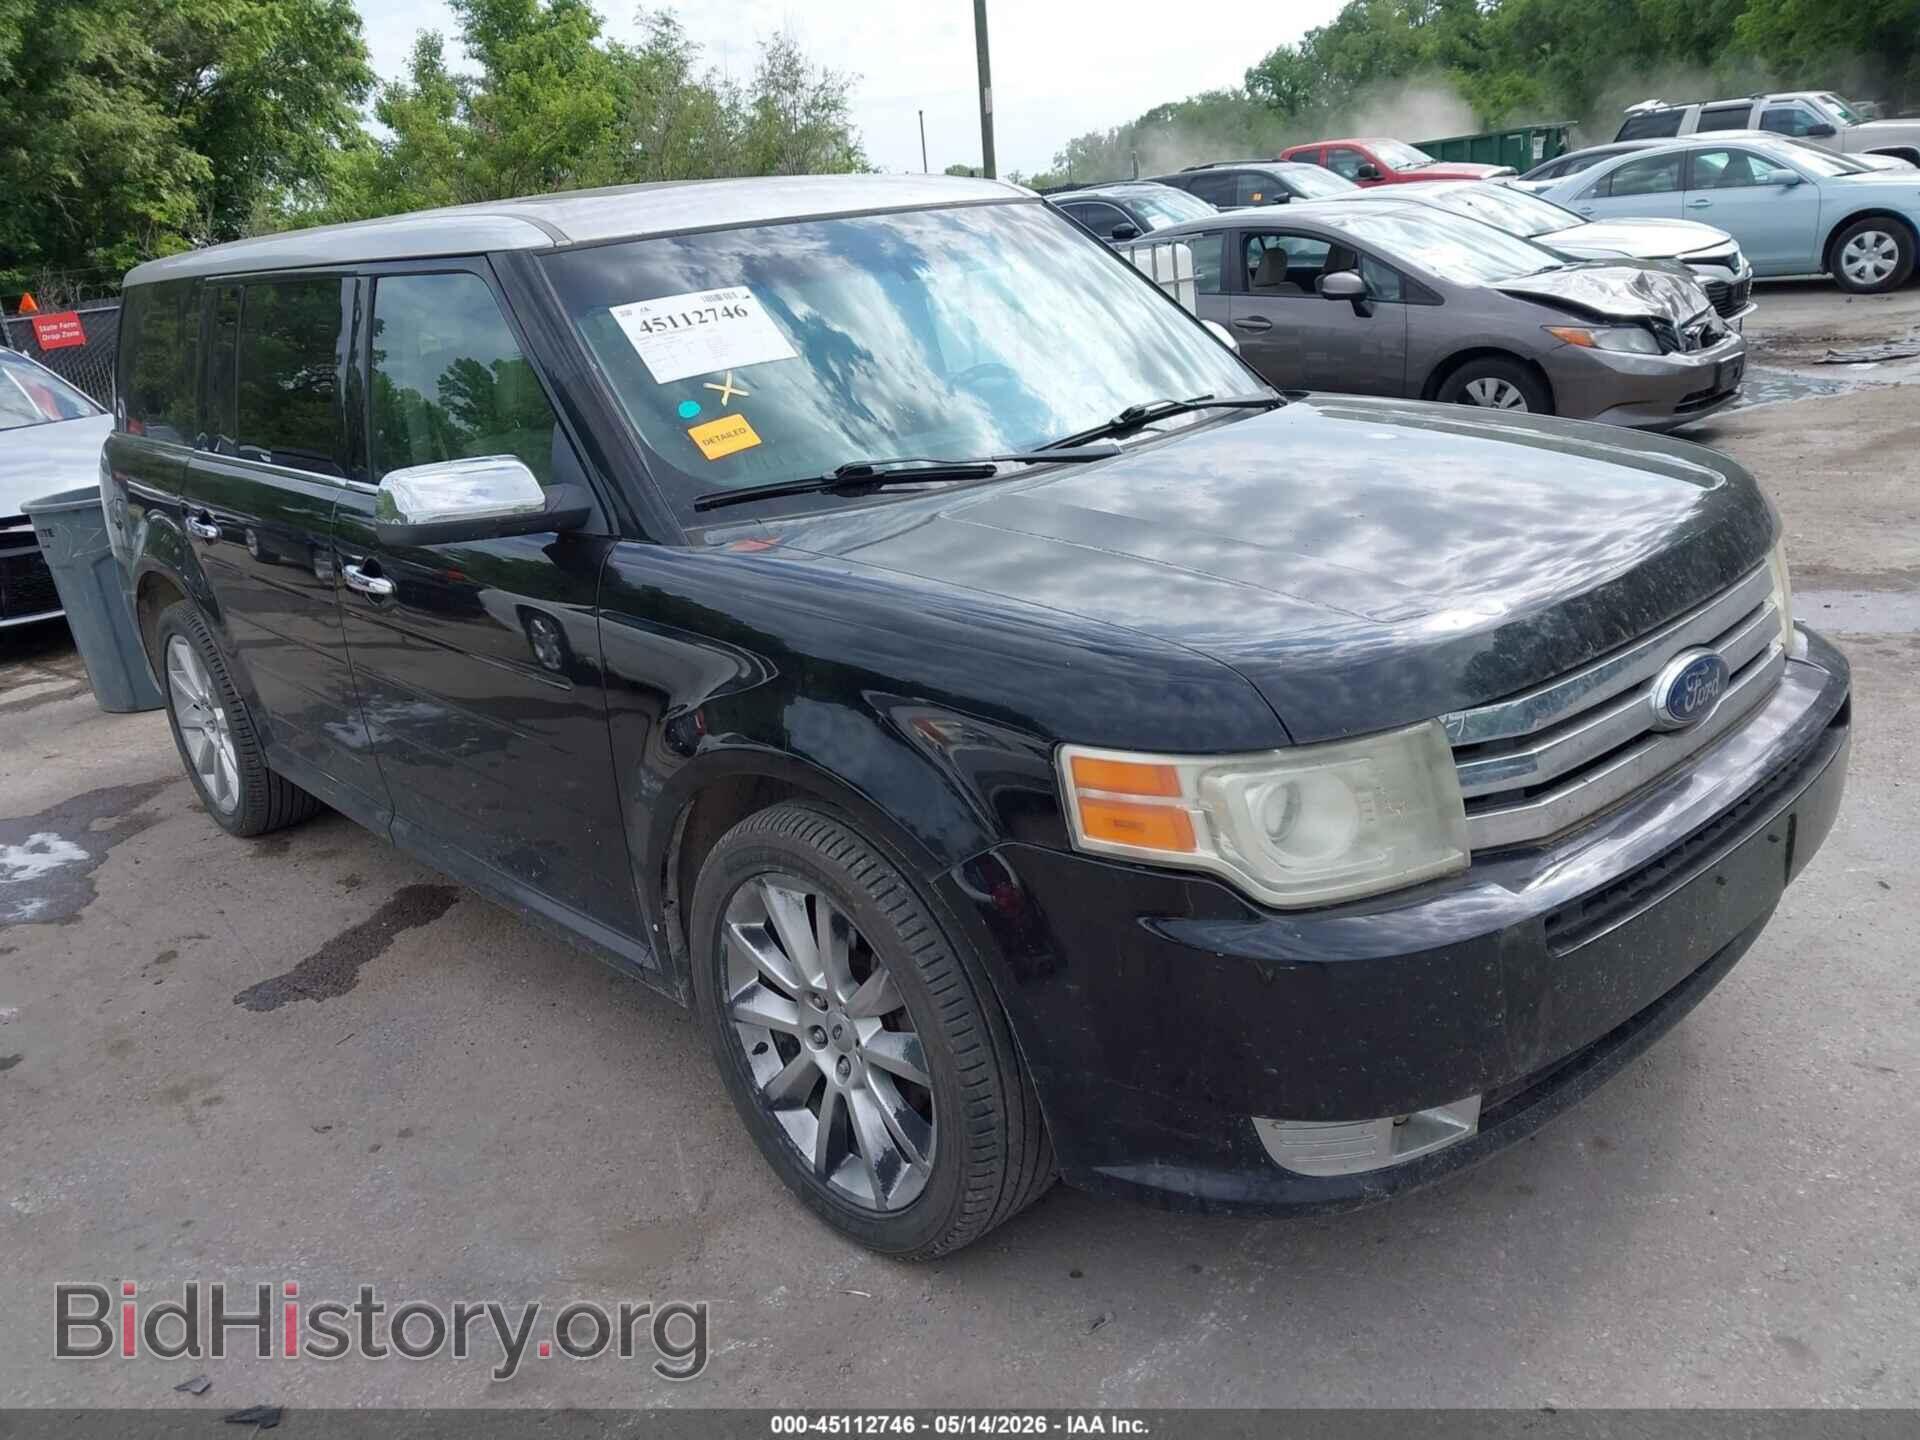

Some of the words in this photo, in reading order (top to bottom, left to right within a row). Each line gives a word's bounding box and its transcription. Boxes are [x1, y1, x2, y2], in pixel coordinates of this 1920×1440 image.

[639, 304, 749, 334] 45112746
[702, 427, 746, 446] DETAILED
[1684, 663, 1721, 713] Ford
